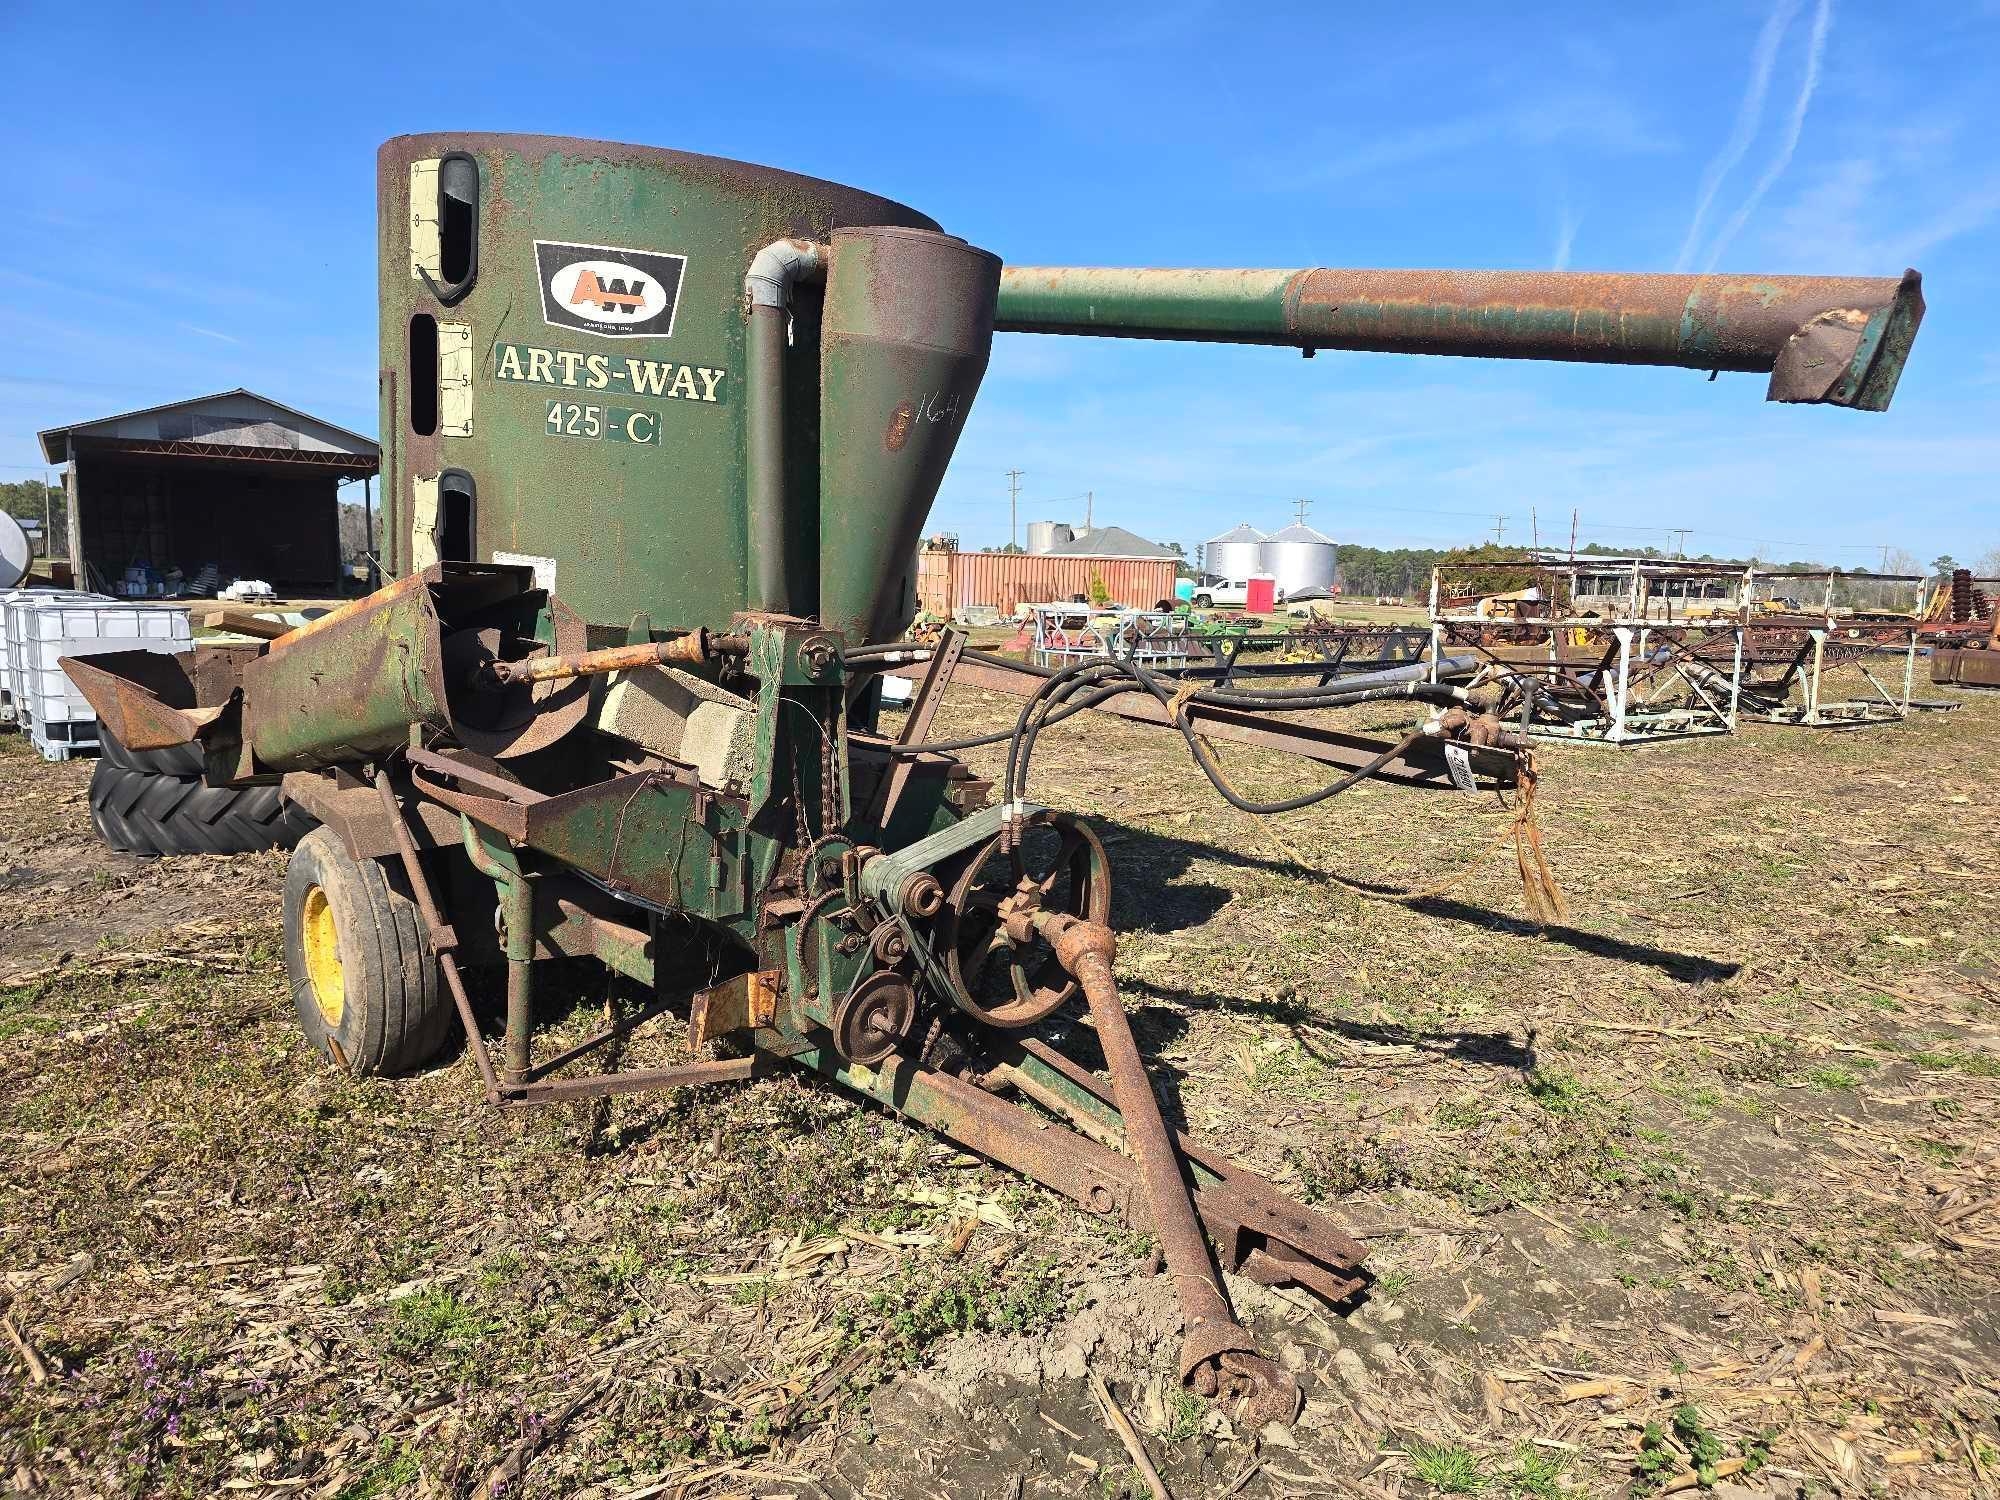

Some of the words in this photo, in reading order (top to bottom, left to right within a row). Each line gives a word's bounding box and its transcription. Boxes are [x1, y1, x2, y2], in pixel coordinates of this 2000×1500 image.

[414, 213, 420, 228] 8
[570, 269, 645, 314] AW
[461, 327, 469, 341] 6
[461, 374, 468, 387] 5
[497, 345, 725, 402] ARTS-WAY
[915, 390, 961, 425] 164
[462, 421, 470, 434] 4
